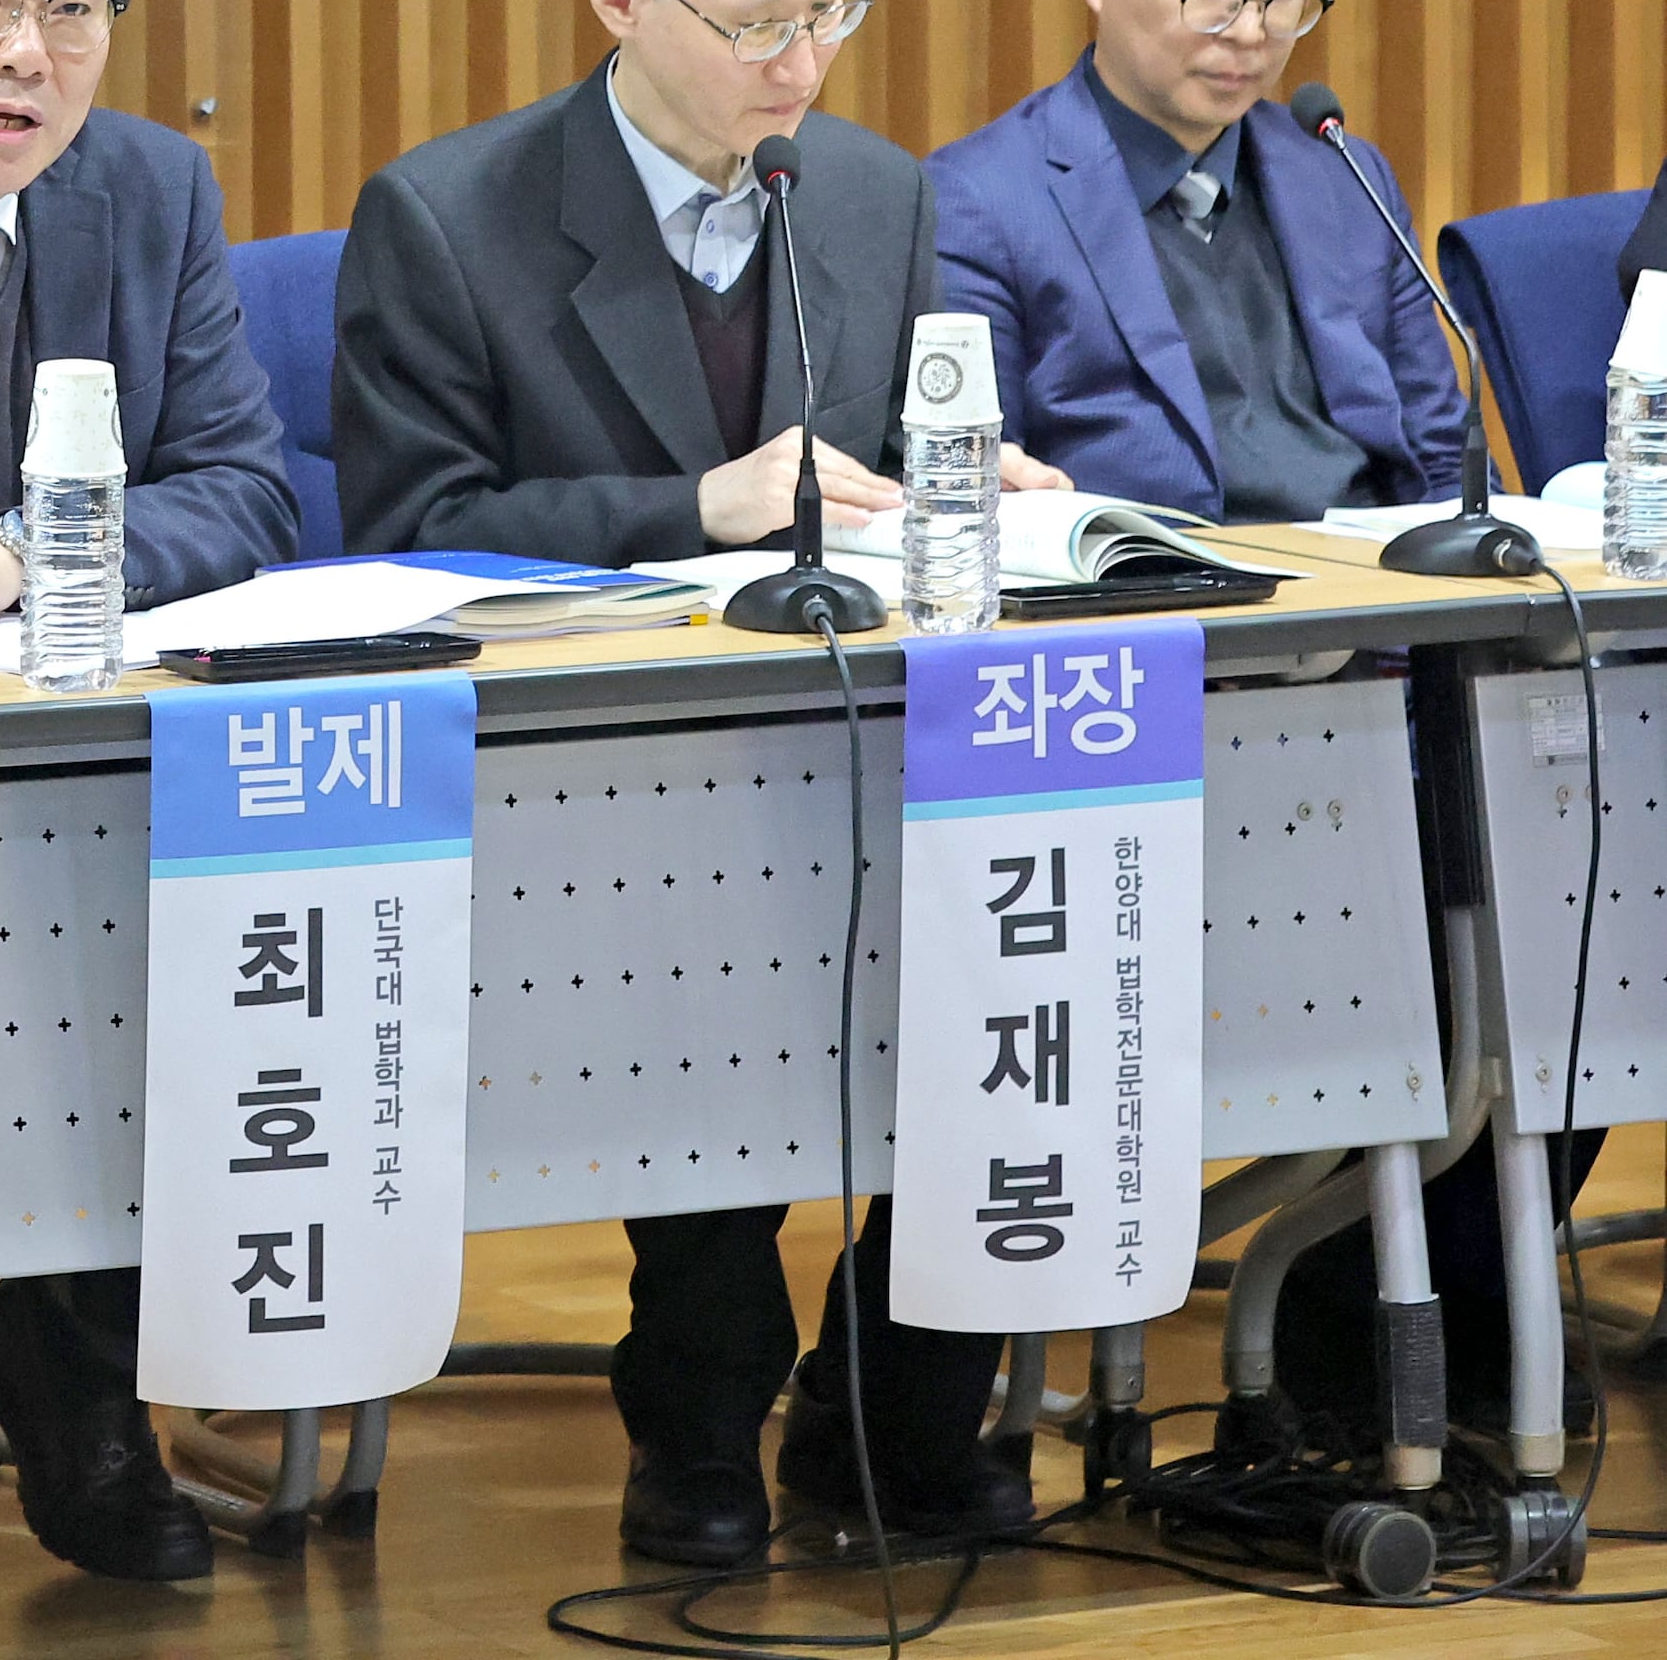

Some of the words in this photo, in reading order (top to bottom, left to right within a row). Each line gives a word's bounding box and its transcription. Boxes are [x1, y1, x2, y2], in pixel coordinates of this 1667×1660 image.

[973, 647, 1143, 757] 좌장
[229, 701, 401, 817] 발제
[1115, 837, 1142, 941] 한양대
[374, 897, 403, 1005] 단국대
[374, 1020, 403, 1128] 법학과
[976, 848, 1073, 1261] 김재봉
[1116, 956, 1143, 1203] 법학전문대학원
[230, 908, 328, 1333] 최호진
[373, 1147, 401, 1215] 교수
[1116, 1220, 1142, 1286] 교수
